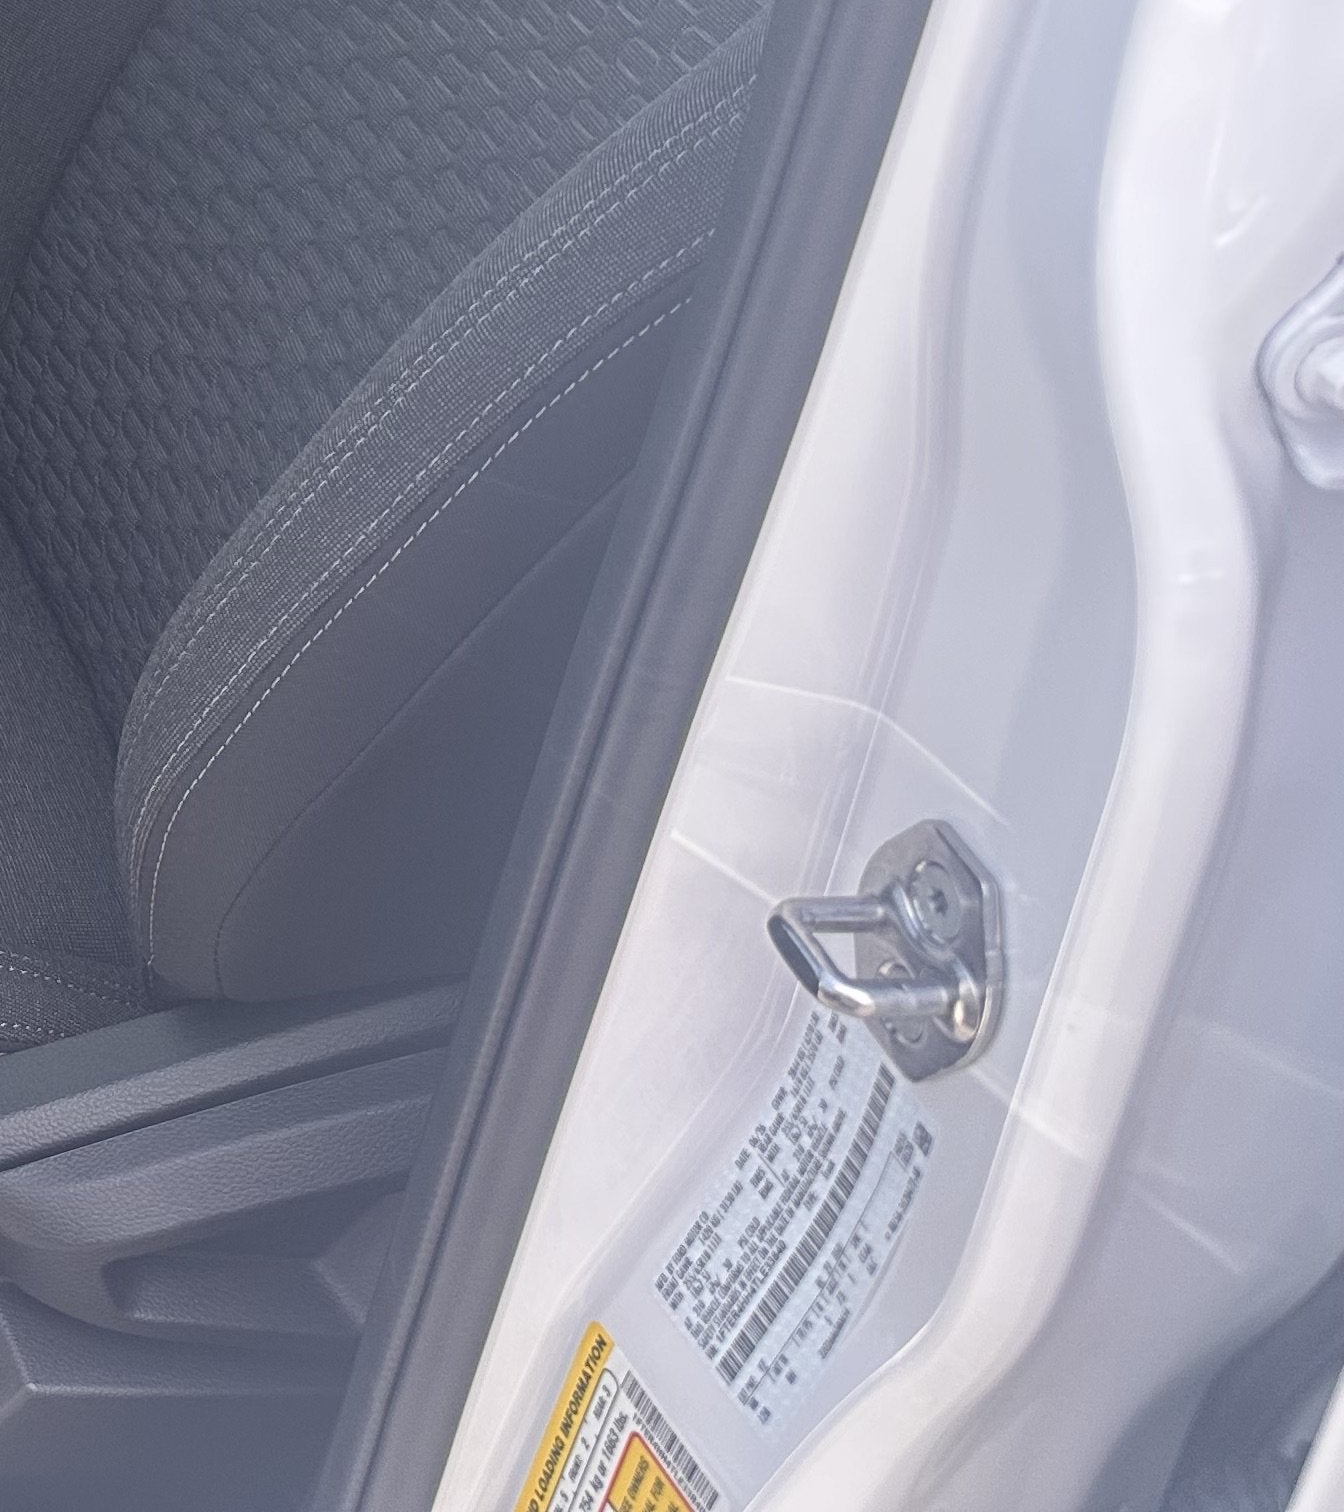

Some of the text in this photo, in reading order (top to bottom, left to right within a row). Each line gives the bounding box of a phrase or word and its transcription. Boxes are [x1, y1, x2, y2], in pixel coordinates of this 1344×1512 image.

[534, 1436, 565, 1501] LOADING
[560, 1333, 607, 1439] INFORMATION
[581, 1436, 589, 1451] 2
[602, 1385, 610, 1397] 3
[590, 1476, 603, 1493] kg
[597, 1461, 607, 1475] or
